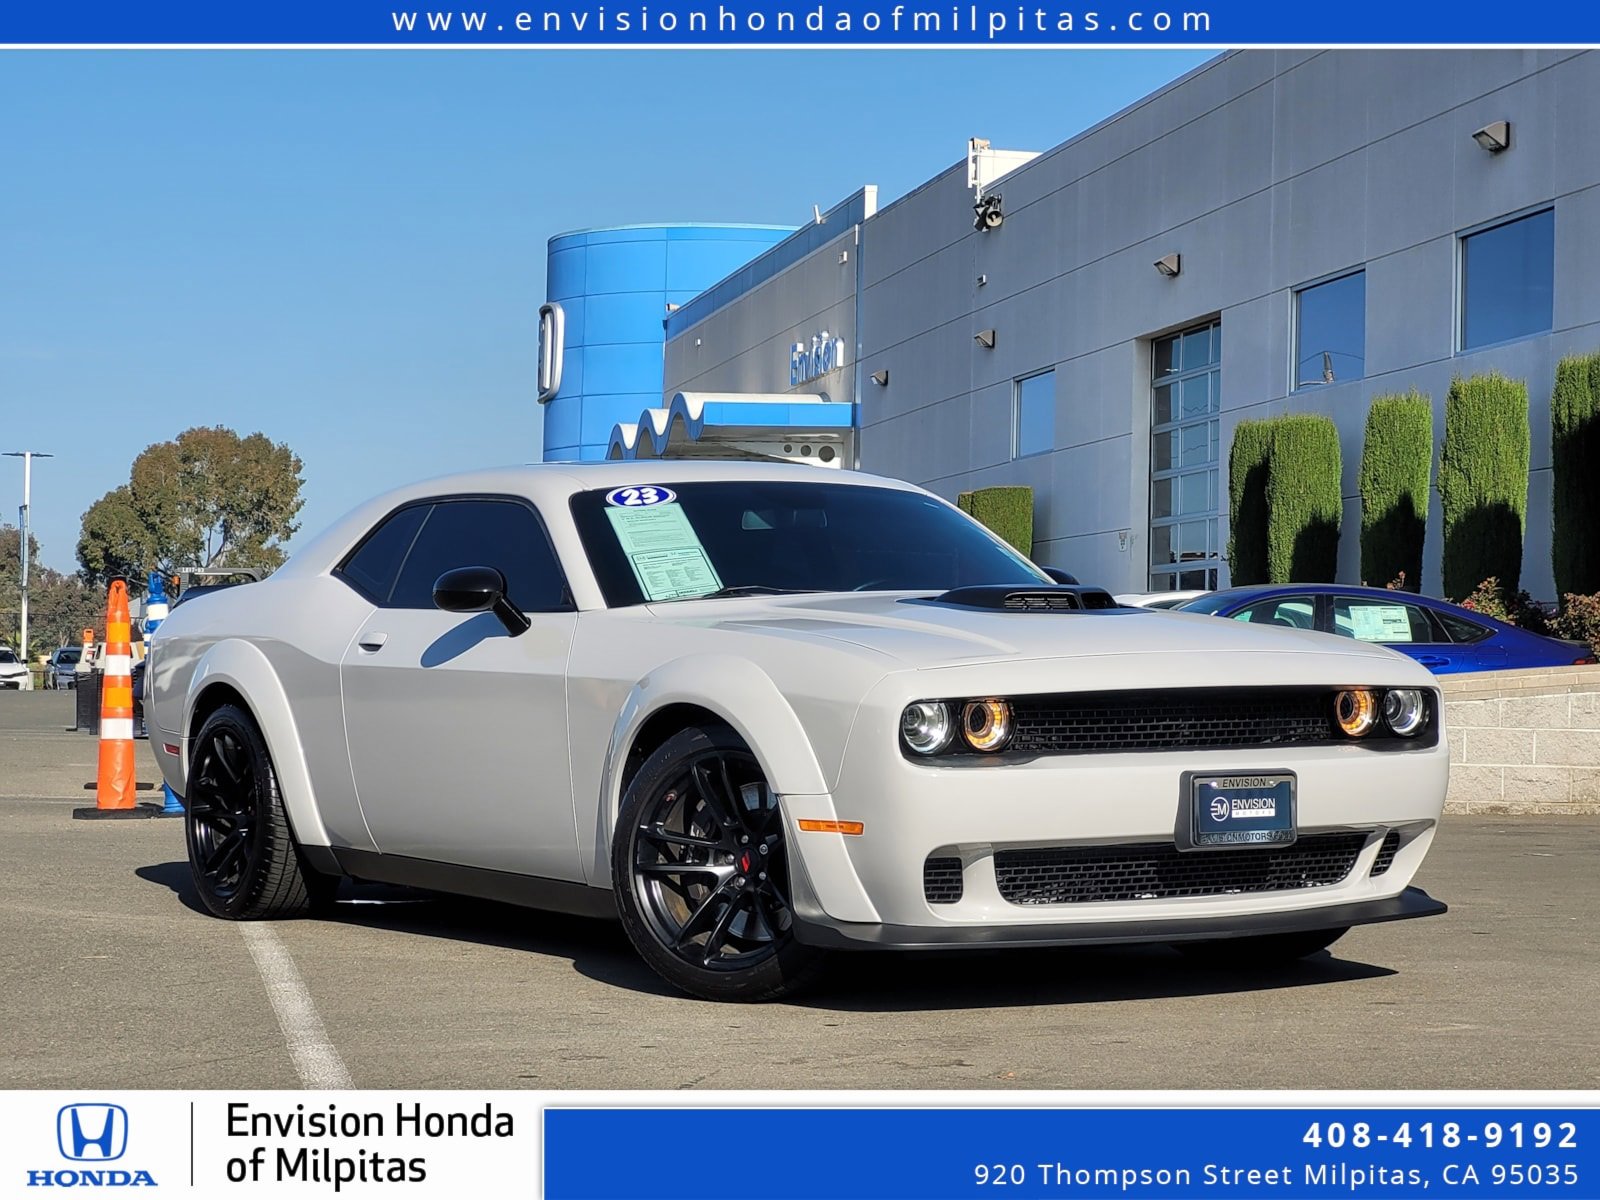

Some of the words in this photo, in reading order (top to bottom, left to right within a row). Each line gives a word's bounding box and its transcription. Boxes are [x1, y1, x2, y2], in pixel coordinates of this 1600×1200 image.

[620, 487, 660, 506] 23
[1222, 778, 1267, 788] ENVISION
[1231, 798, 1276, 810] ENVISION
